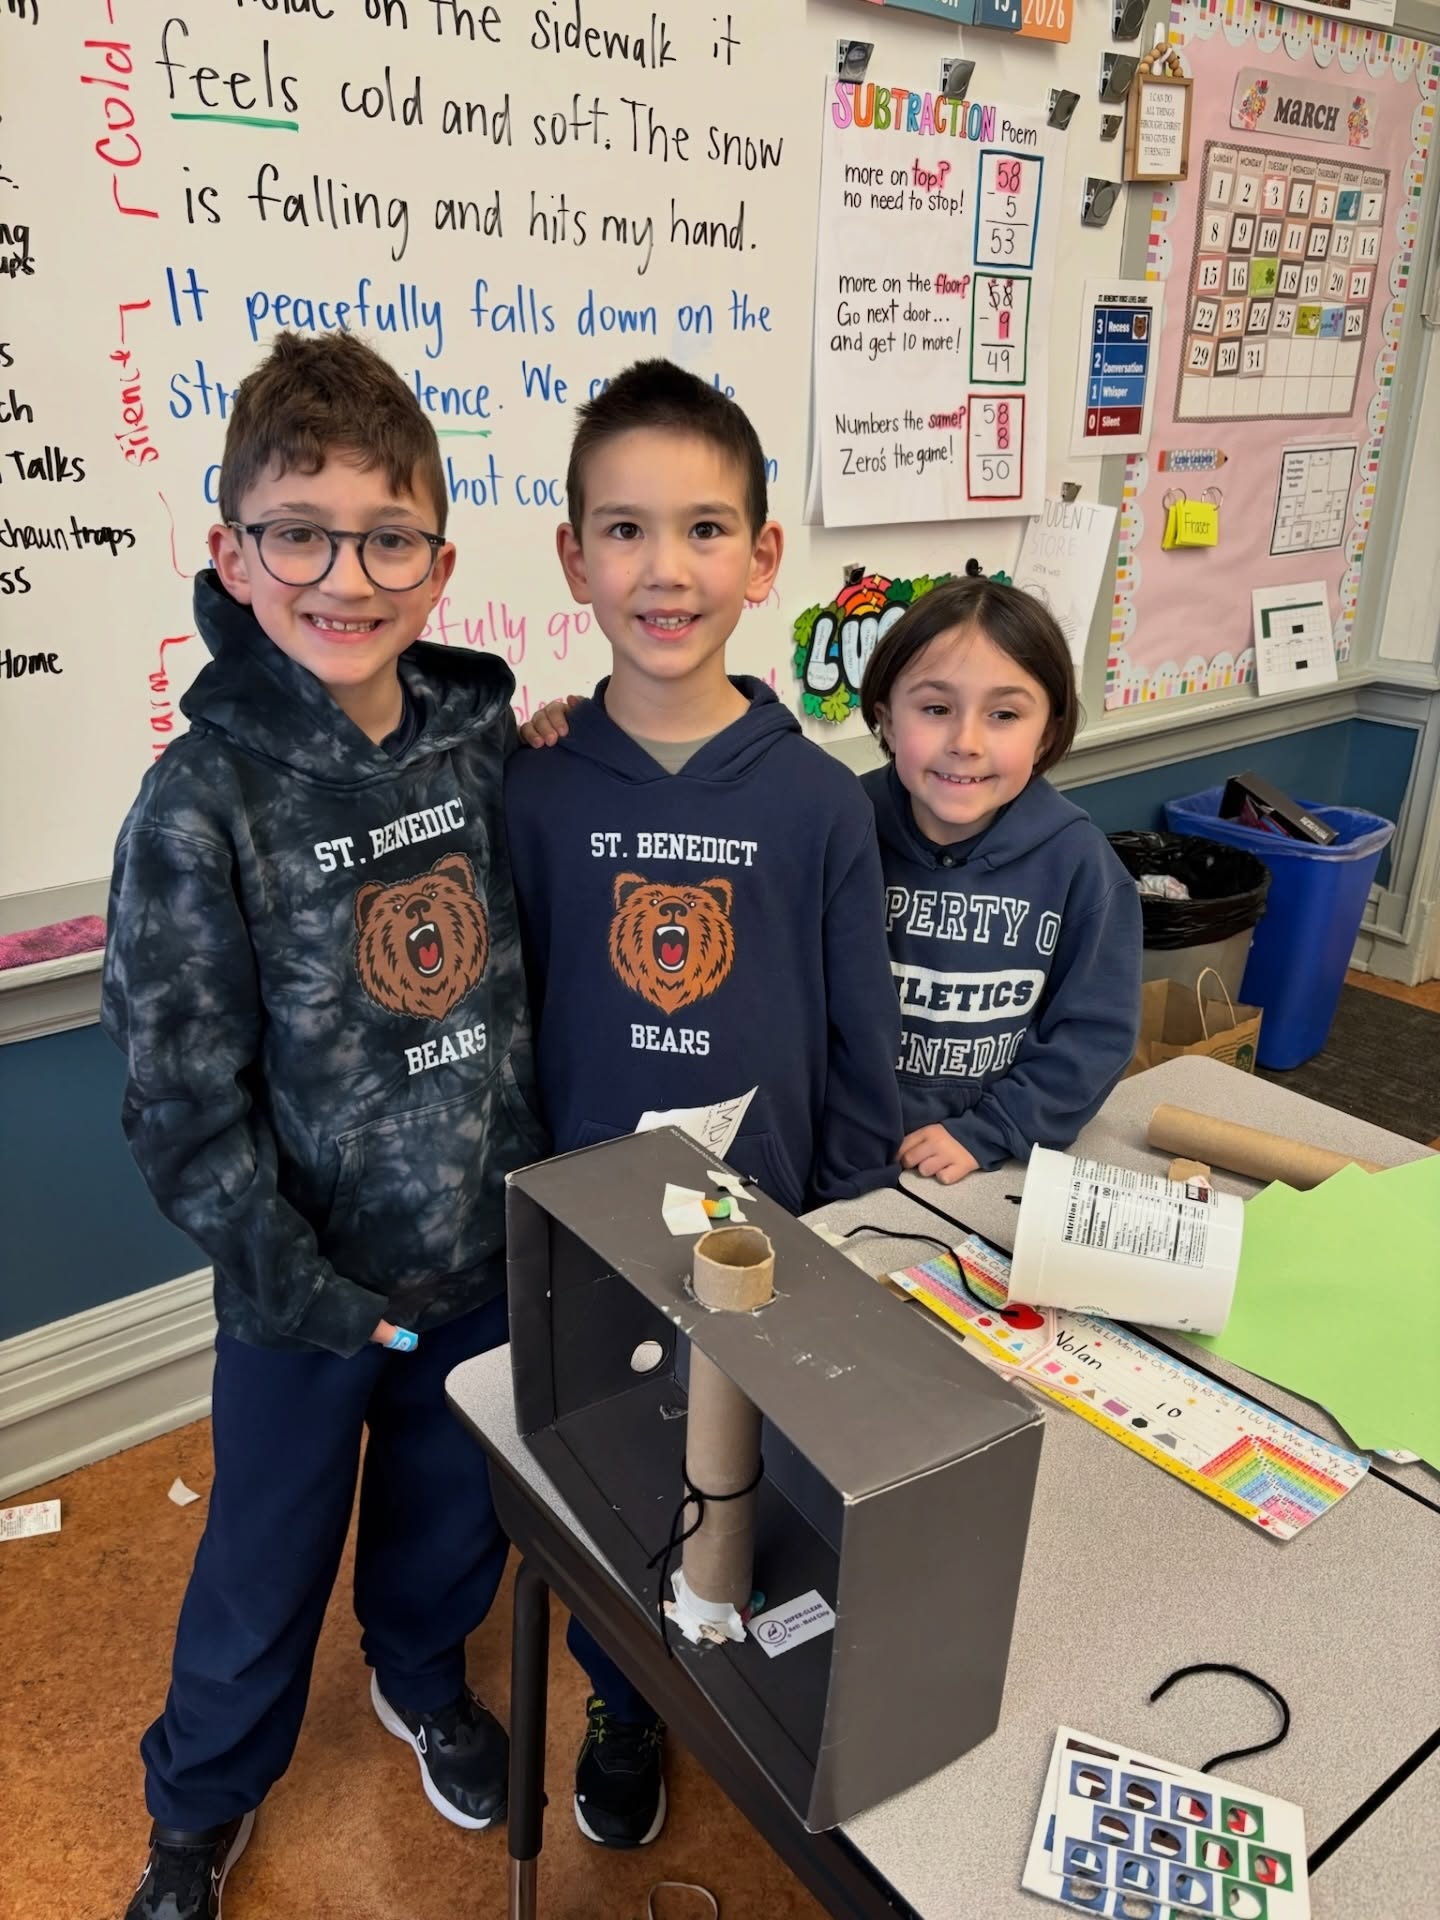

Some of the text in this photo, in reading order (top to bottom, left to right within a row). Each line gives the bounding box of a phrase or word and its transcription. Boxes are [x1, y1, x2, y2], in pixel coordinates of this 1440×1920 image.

[1023, 0, 1065, 29] 2026
[531, 0, 678, 69] sidewalk
[712, 14, 741, 65] it
[155, 17, 783, 171] feels cold and soft. The snow
[832, 80, 1037, 147] SUBTRACTION Poem
[844, 158, 952, 192] more on top?
[996, 161, 1022, 192] 58
[1213, 153, 1234, 165] SUNDAY
[1240, 157, 1263, 169] MONDAY
[1267, 161, 1289, 172] TUESDAY
[1344, 171, 1360, 182] FRIDAY
[843, 189, 964, 216] no need to stop!
[1005, 196, 1017, 218] 5
[1218, 179, 1376, 218] 1 2 3 4 5 7
[182, 163, 757, 275] is falling and hits my hand.
[990, 227, 1016, 255] 53
[1211, 222, 1375, 256] 8 9 10 11 12 13 14
[838, 273, 971, 299] more on the floor?
[1203, 266, 1367, 296] 15 16 18 19 20 21
[166, 267, 772, 360] It peacefully falls down on the
[836, 299, 950, 327] Go next door...
[1000, 311, 1010, 339] 9
[1096, 318, 1130, 335] 3 Recess
[1194, 307, 1213, 329] 22
[1226, 307, 1241, 328] 23
[1250, 308, 1266, 328] 24
[1276, 310, 1291, 329] 25
[1347, 314, 1361, 333] 28
[830, 327, 962, 361] and get 10 more!
[1192, 346, 1261, 369] 29 30 31
[987, 350, 1011, 374] 49
[1094, 354, 1144, 374] 2 Conversation
[404, 371, 503, 419] lence.
[522, 360, 568, 403] We
[1091, 385, 1128, 400] 1 Whisper
[836, 405, 966, 436] Numbers the same?
[983, 403, 1010, 426] 58
[1089, 414, 1121, 430] 0 Silent
[997, 427, 1009, 450] 8
[5, 445, 86, 483] Talks
[840, 435, 954, 475] Zero's the game!
[981, 460, 1010, 482] 50
[448, 454, 504, 507] hot
[70, 515, 136, 557] traps
[314, 797, 465, 873] ST. BENEDIC
[590, 832, 758, 867] ST. BENEDICT
[885, 886, 1062, 956] PERTY O
[894, 974, 1034, 1012] LETICS
[404, 1022, 487, 1076] BEARS
[630, 1023, 711, 1056] BEARS
[1064, 1202, 1078, 1241] Nutrition
[1056, 1330, 1102, 1370] Nolan
[783, 1603, 823, 1625] SUPER-CLEAN
